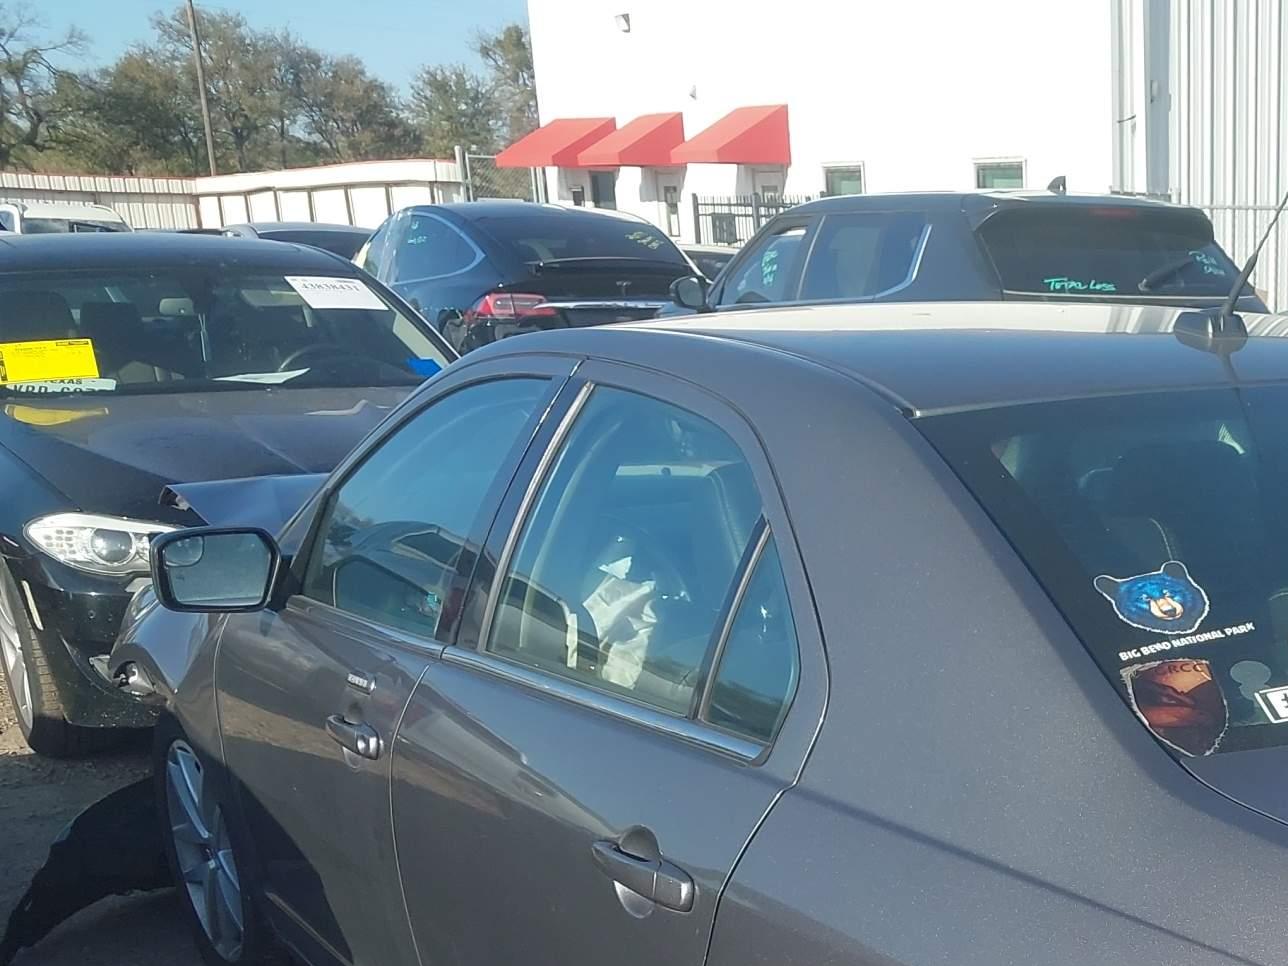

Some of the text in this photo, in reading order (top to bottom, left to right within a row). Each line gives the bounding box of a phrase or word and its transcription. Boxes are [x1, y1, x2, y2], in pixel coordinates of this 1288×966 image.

[1118, 621, 1256, 661] BIG BEND NATIONAL PARK
